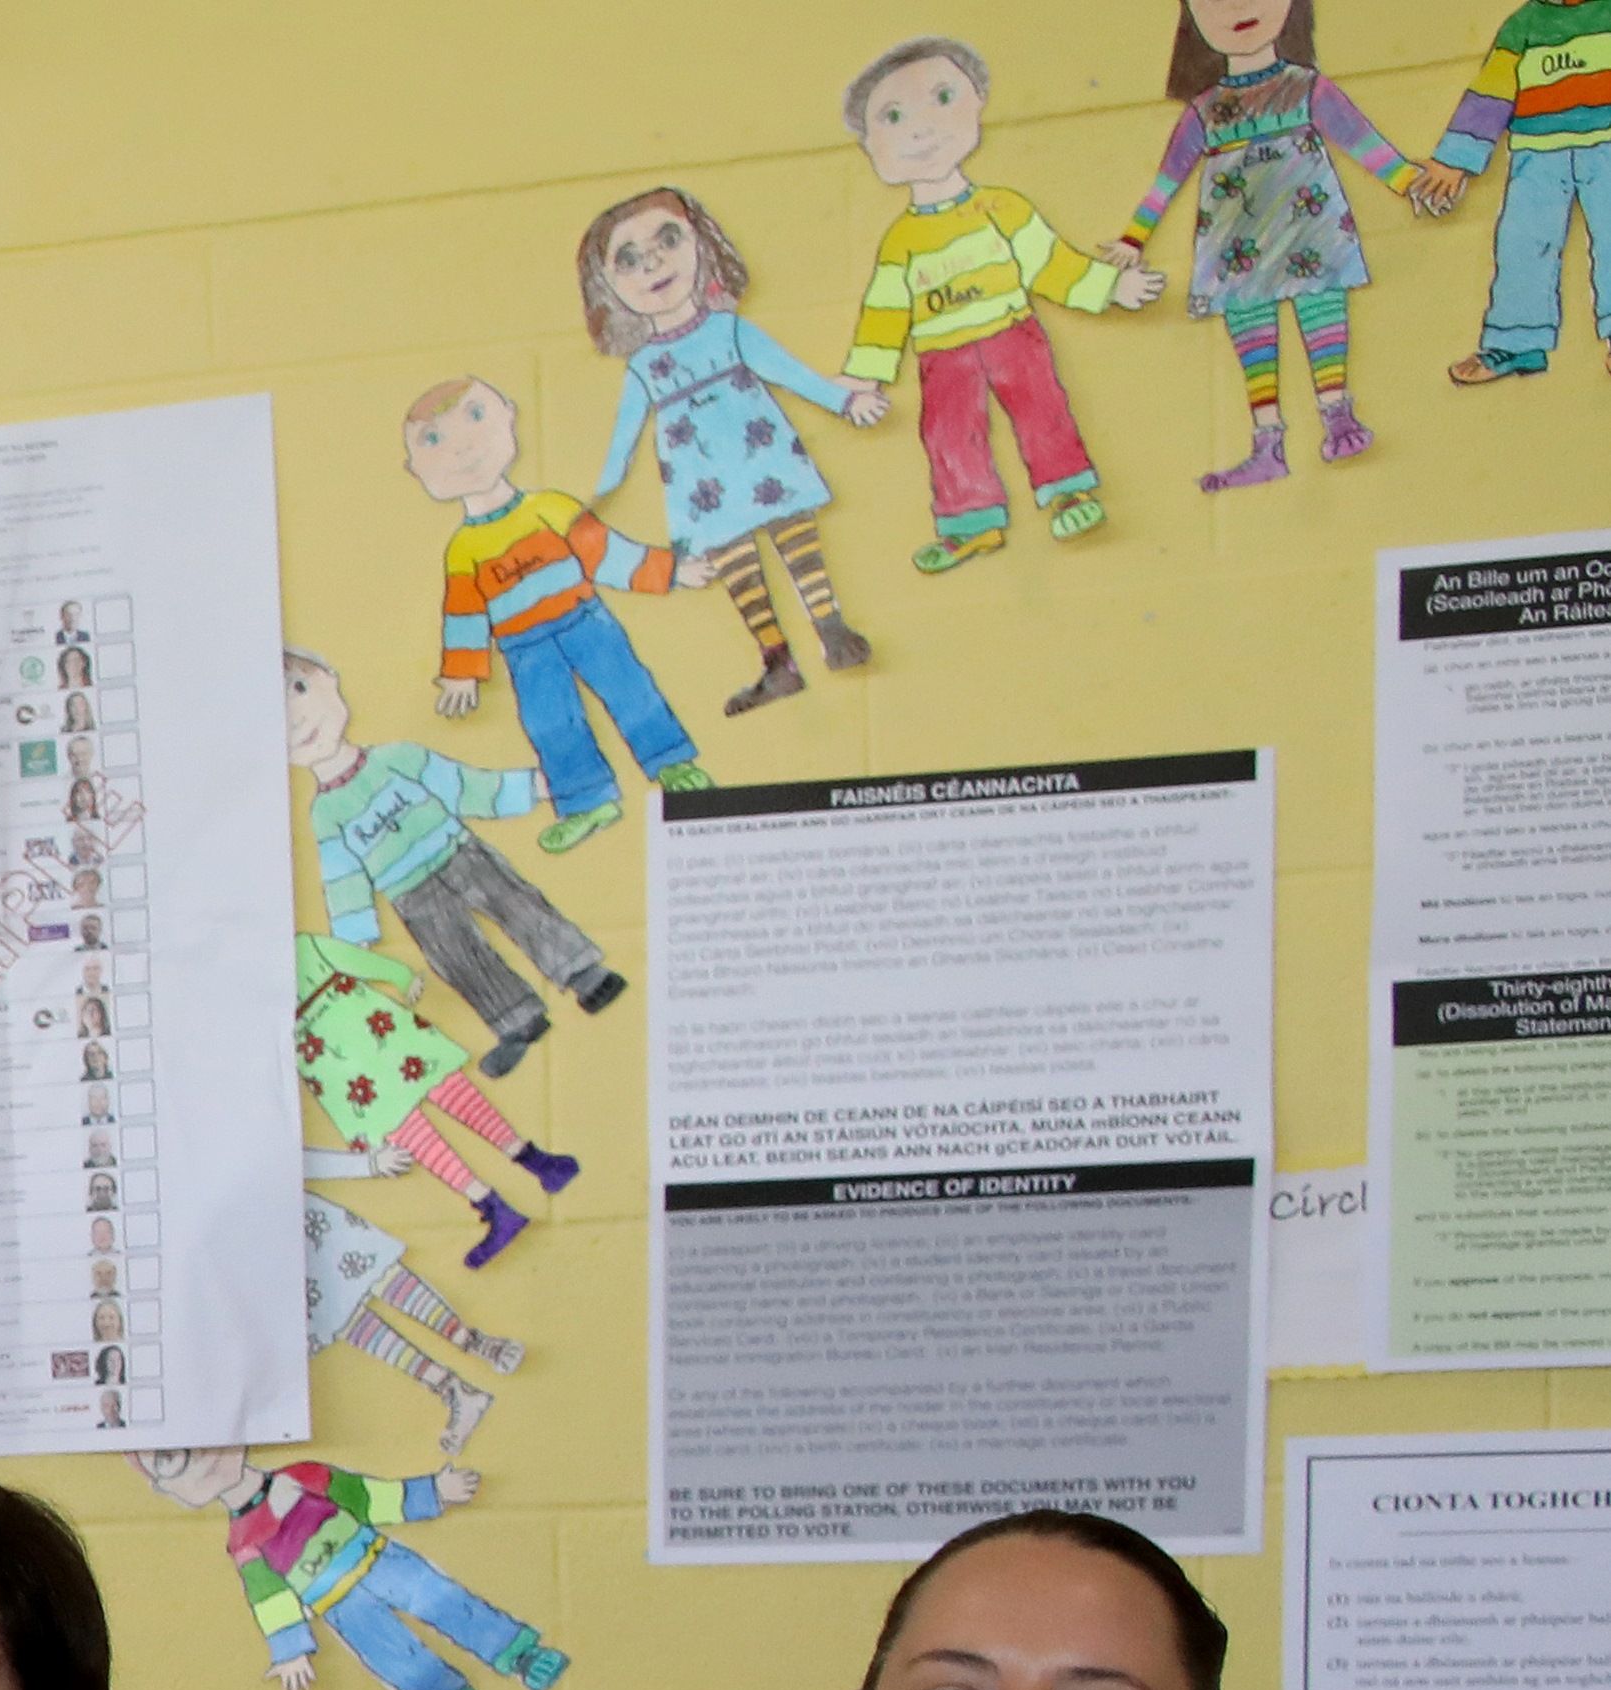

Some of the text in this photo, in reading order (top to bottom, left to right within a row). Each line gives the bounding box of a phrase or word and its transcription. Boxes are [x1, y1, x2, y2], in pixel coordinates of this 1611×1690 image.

[1433, 575, 1462, 591] An
[1468, 570, 1510, 589] Bille
[1517, 569, 1548, 584] um
[1553, 567, 1579, 581] an
[1425, 590, 1545, 615] (Scaoileadh
[1550, 588, 1573, 602] ar
[1519, 607, 1548, 624] An
[830, 773, 1080, 807] FAISNÉIS CÉANNACHTA
[1437, 1000, 1555, 1024] (Dissolution
[1560, 995, 1580, 1013] of
[669, 1112, 718, 1130] DÉAN
[725, 1110, 797, 1129] DEIMHIN
[804, 1109, 829, 1122] DE
[835, 1105, 897, 1122] CEANN
[903, 1104, 928, 1119] DE
[933, 1104, 958, 1117] NA
[1047, 1097, 1087, 1112] SEO
[1092, 1096, 1105, 1110] A
[1111, 1090, 1219, 1108] THABHAIRT
[669, 1134, 713, 1150] LEAT
[719, 1133, 746, 1147] GO
[783, 1128, 808, 1143] AN
[814, 1124, 897, 1143] STÁISIÚN
[1032, 1118, 1086, 1131] MUNA
[1173, 1110, 1241, 1125] CEANN
[671, 1154, 707, 1168] ACU
[767, 1150, 822, 1164] BEIDH
[827, 1144, 887, 1160] SEANS
[894, 1143, 932, 1158] ANN
[937, 1141, 990, 1156] NACH
[1117, 1132, 1159, 1148] DUIT
[833, 1174, 1077, 1200] EVIDENCE OF IDENTITY
[669, 1476, 1197, 1502] BE SURE TO BRING ONE OF THESE DOCUMENTS WITH YOU
[669, 1508, 691, 1520] TO
[699, 1506, 731, 1520] THE
[737, 1504, 815, 1518] POLLING
[906, 1499, 1012, 1517] OTHERWISE
[1021, 1499, 1059, 1512] YOU
[1063, 1499, 1103, 1512] MAY
[1108, 1497, 1149, 1511] NOT
[1152, 1496, 1178, 1510] BE
[1372, 1493, 1479, 1513] CIONTA
[669, 1525, 769, 1540] PERMITTED
[777, 1524, 799, 1538] TO
